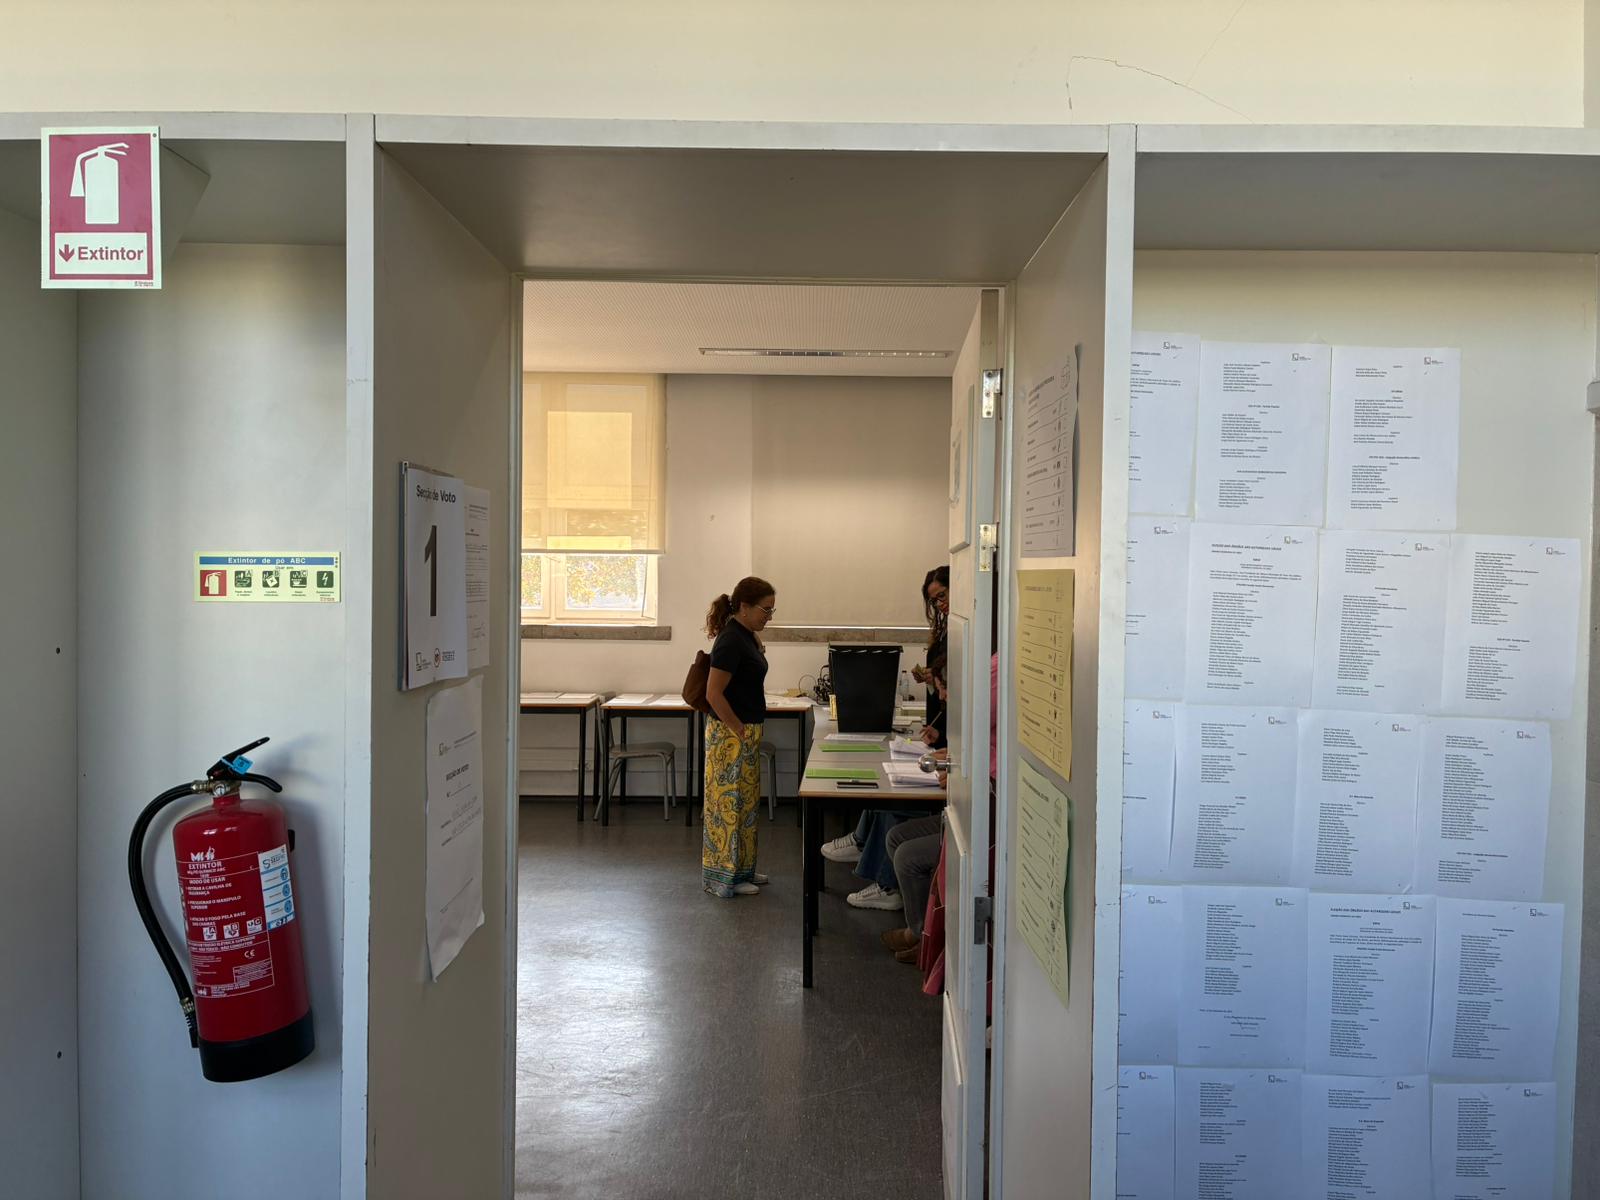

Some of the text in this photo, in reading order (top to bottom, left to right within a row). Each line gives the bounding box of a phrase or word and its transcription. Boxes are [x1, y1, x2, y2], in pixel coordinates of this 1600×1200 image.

[78, 246, 144, 262] Extintor
[439, 489, 457, 504] Voto
[424, 524, 438, 617] 1
[188, 861, 222, 870] EXTINTOR
